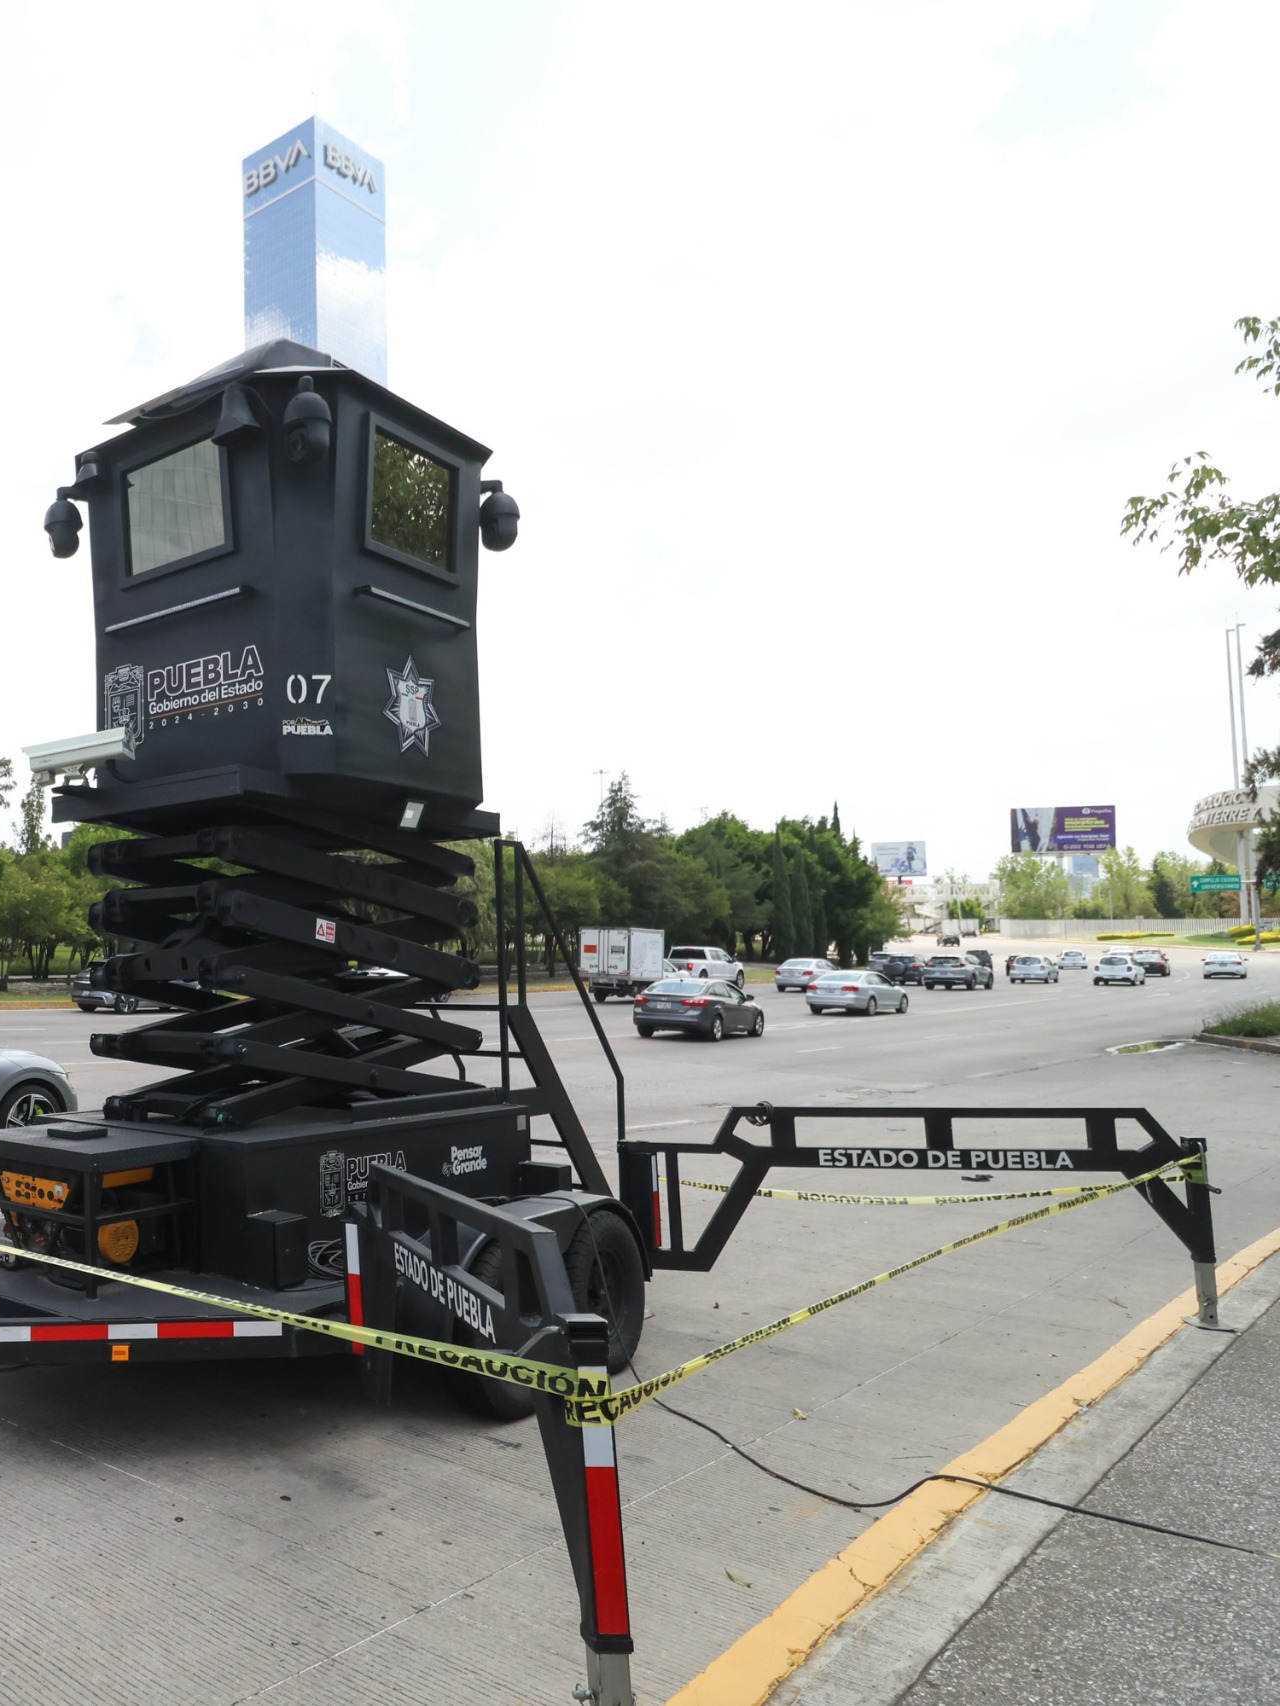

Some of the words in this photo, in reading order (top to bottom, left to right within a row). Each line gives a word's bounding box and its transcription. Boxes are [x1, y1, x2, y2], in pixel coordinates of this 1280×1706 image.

[242, 138, 312, 198] BBVA
[323, 142, 377, 195] BBVA
[147, 644, 264, 702] PUEBLA
[148, 695, 200, 715] Gobierno
[200, 686, 219, 703] del
[221, 678, 263, 699] Estado
[285, 674, 332, 704] 07
[405, 684, 420, 696] SSP
[282, 725, 334, 736] PUEBLA
[450, 1145, 483, 1162] Pensar
[452, 1156, 487, 1175] Grande
[818, 1149, 919, 1167] ESTADO
[927, 1150, 962, 1168] DE
[970, 1151, 1074, 1170] PUEBLA
[394, 1241, 429, 1292] ESTADO
[429, 1265, 446, 1305] DE
[446, 1277, 497, 1345] PUEBLA
